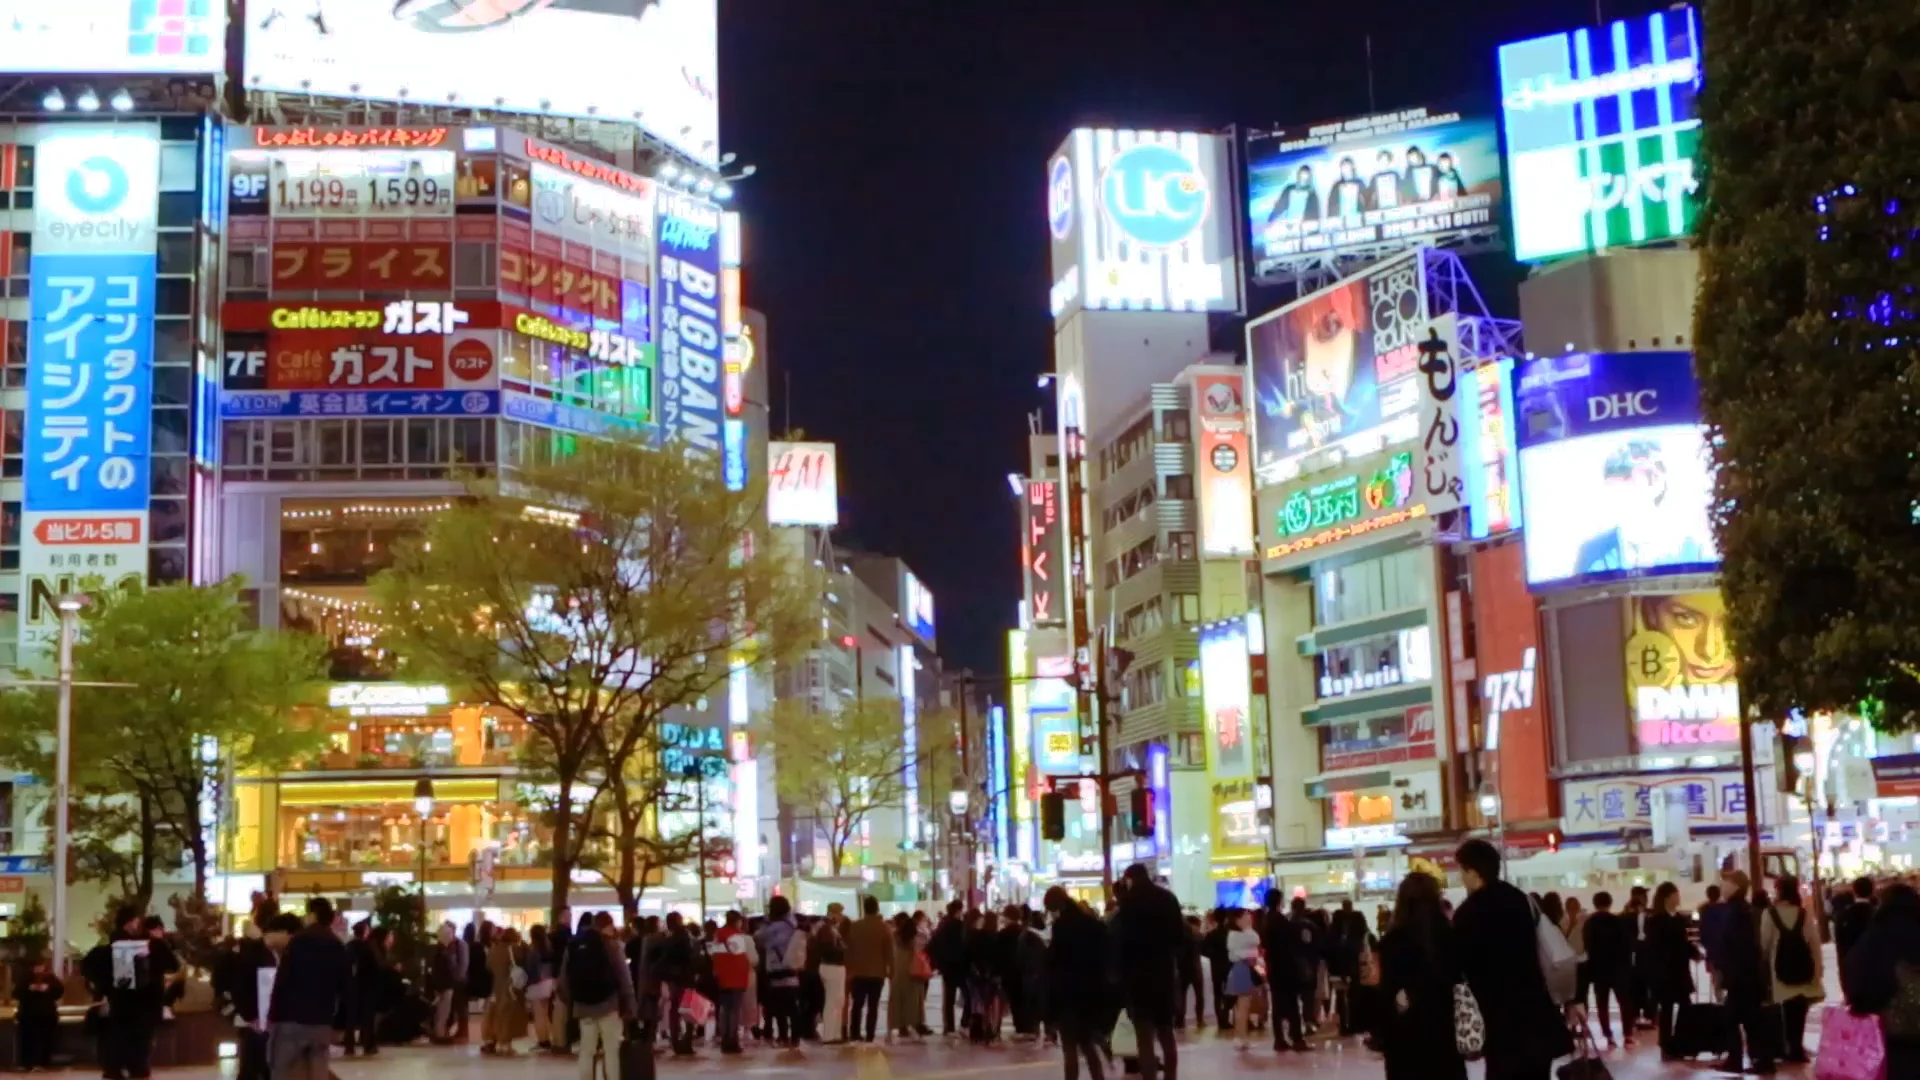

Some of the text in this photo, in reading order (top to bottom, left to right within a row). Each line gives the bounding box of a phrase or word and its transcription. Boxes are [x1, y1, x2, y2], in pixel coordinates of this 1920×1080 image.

[256, 126, 448, 147] しゃぶしゃぶバイキング
[231, 173, 268, 197] 9F
[500, 252, 618, 309] コンタクト
[383, 300, 469, 334] ガスト
[1373, 288, 1421, 332] GO
[226, 351, 267, 376] 7F
[276, 350, 322, 369] Café
[328, 344, 433, 385] ガスト
[455, 357, 488, 369] ガスト
[590, 329, 644, 368] ガスト
[41, 276, 96, 492] アイシティ
[99, 275, 140, 490] コンタクトの
[299, 392, 454, 413] 英会話イーオン
[1417, 327, 1464, 502] もんじゃ
[1587, 389, 1659, 422] DHC
[46, 521, 134, 541] 当ビル5階
[50, 553, 119, 567] 利用者数
